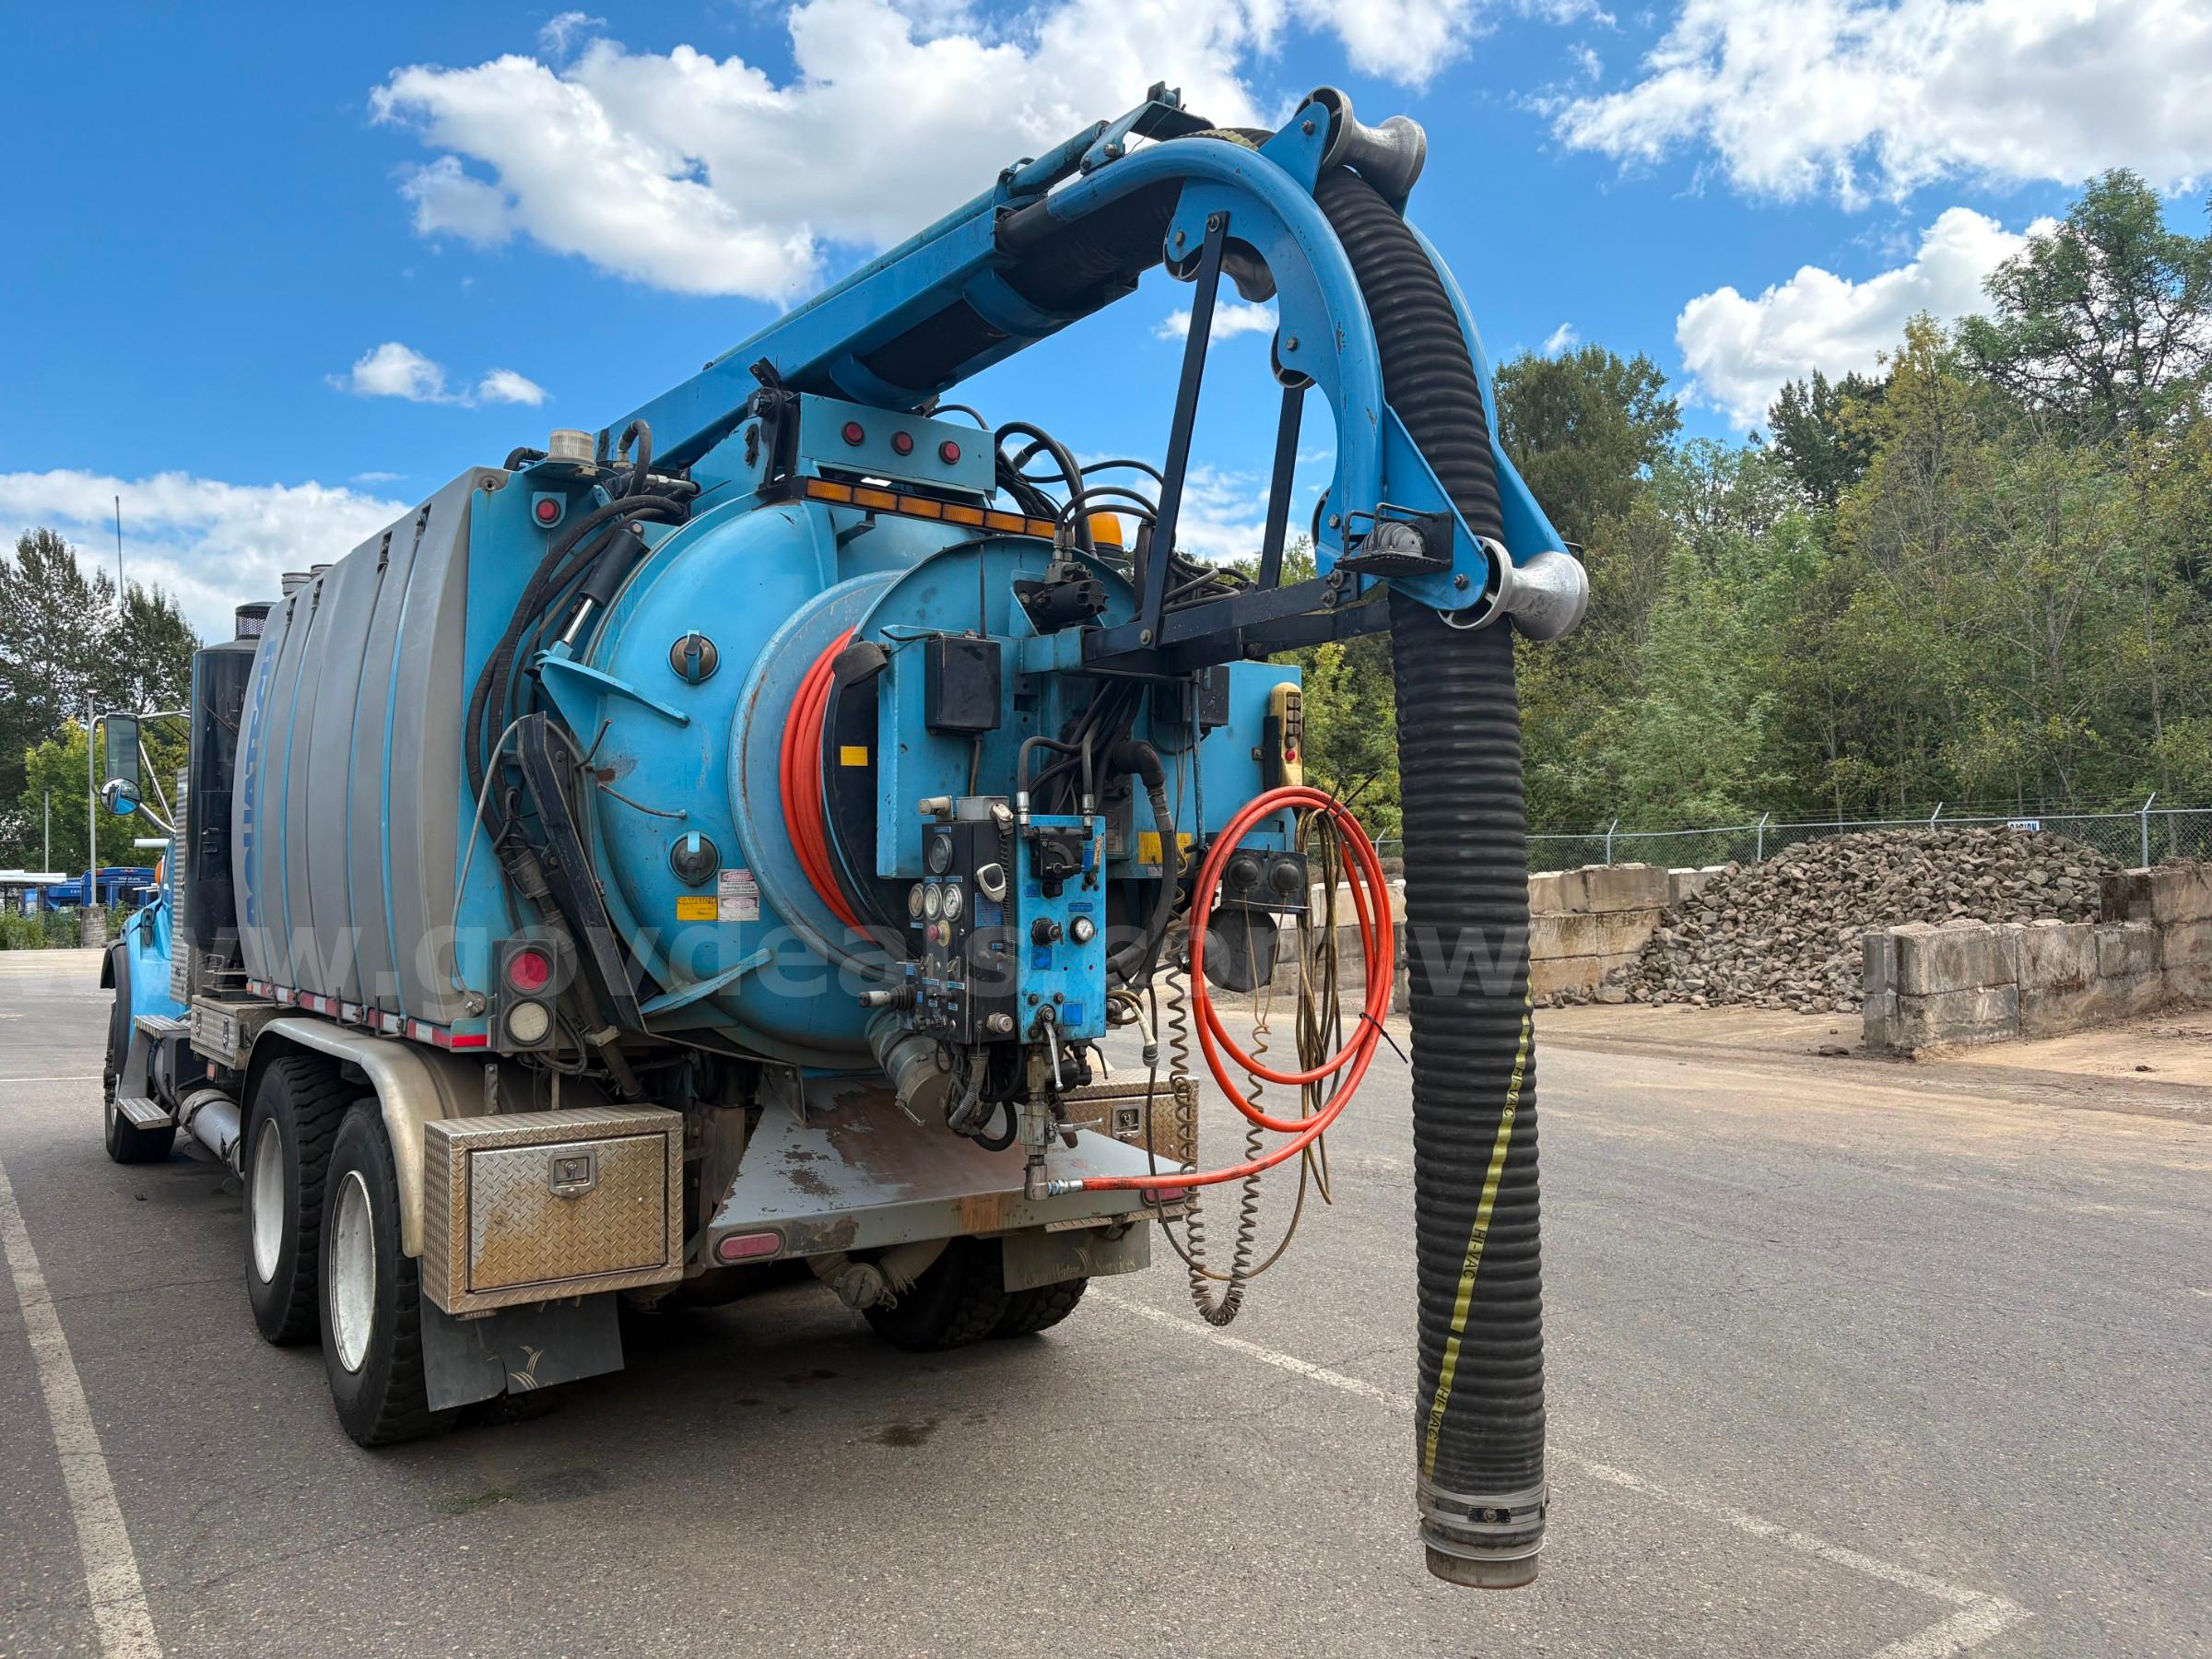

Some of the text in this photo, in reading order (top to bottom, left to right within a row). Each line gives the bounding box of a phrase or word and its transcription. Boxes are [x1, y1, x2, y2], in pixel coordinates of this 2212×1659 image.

[1504, 1067, 1524, 1117] HI-VAC
[1464, 1229, 1486, 1279] HI-VAC
[1429, 1387, 1449, 1440] HI-VAC
